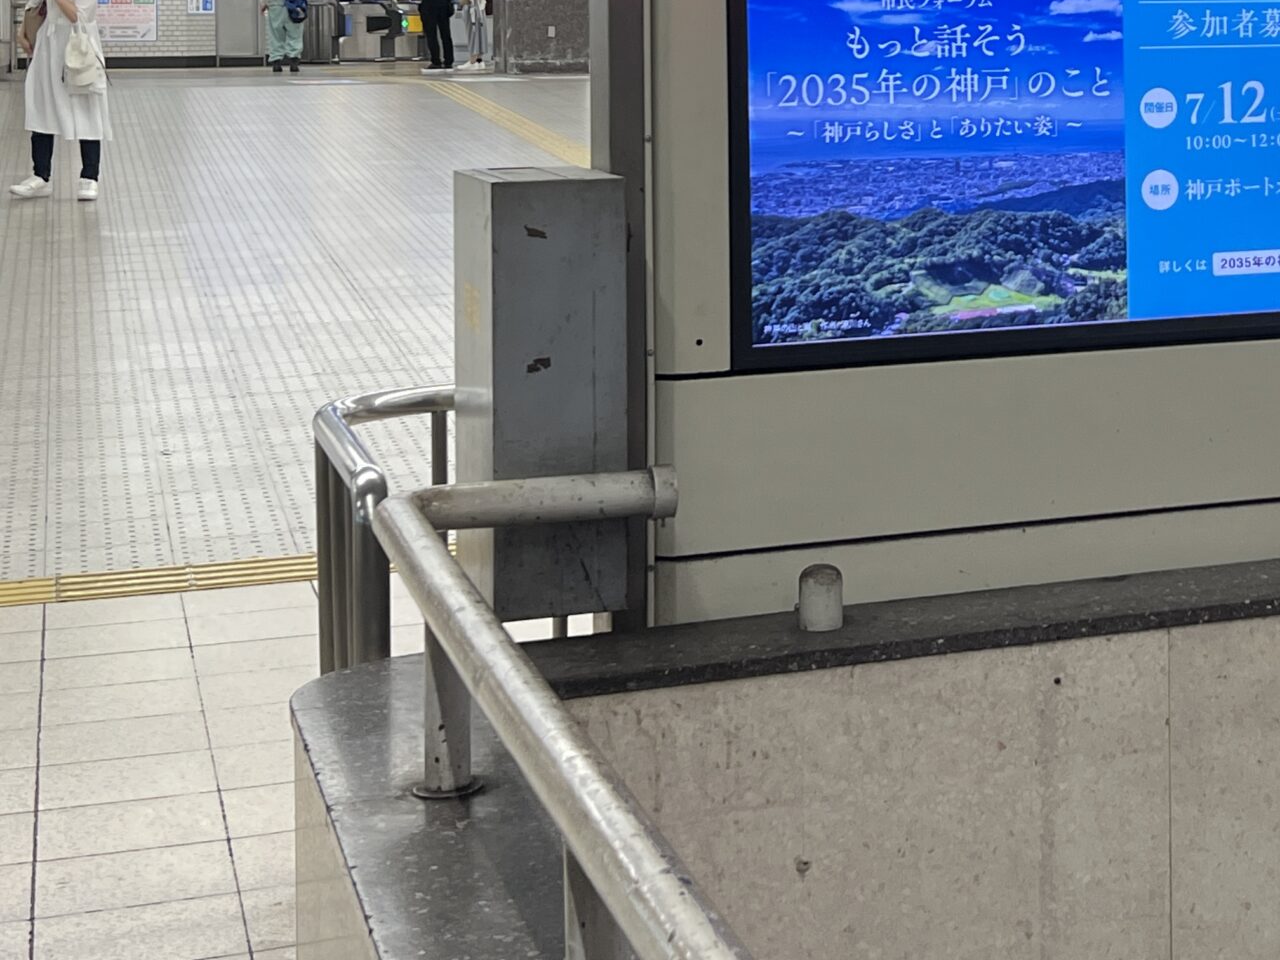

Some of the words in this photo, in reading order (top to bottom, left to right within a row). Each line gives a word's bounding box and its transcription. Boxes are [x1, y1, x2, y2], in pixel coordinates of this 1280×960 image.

[846, 23, 1026, 59] もっと話そう
[765, 66, 1111, 108] 「2035年の神戸」のこと
[1159, 259, 1207, 273] 詳しくは
